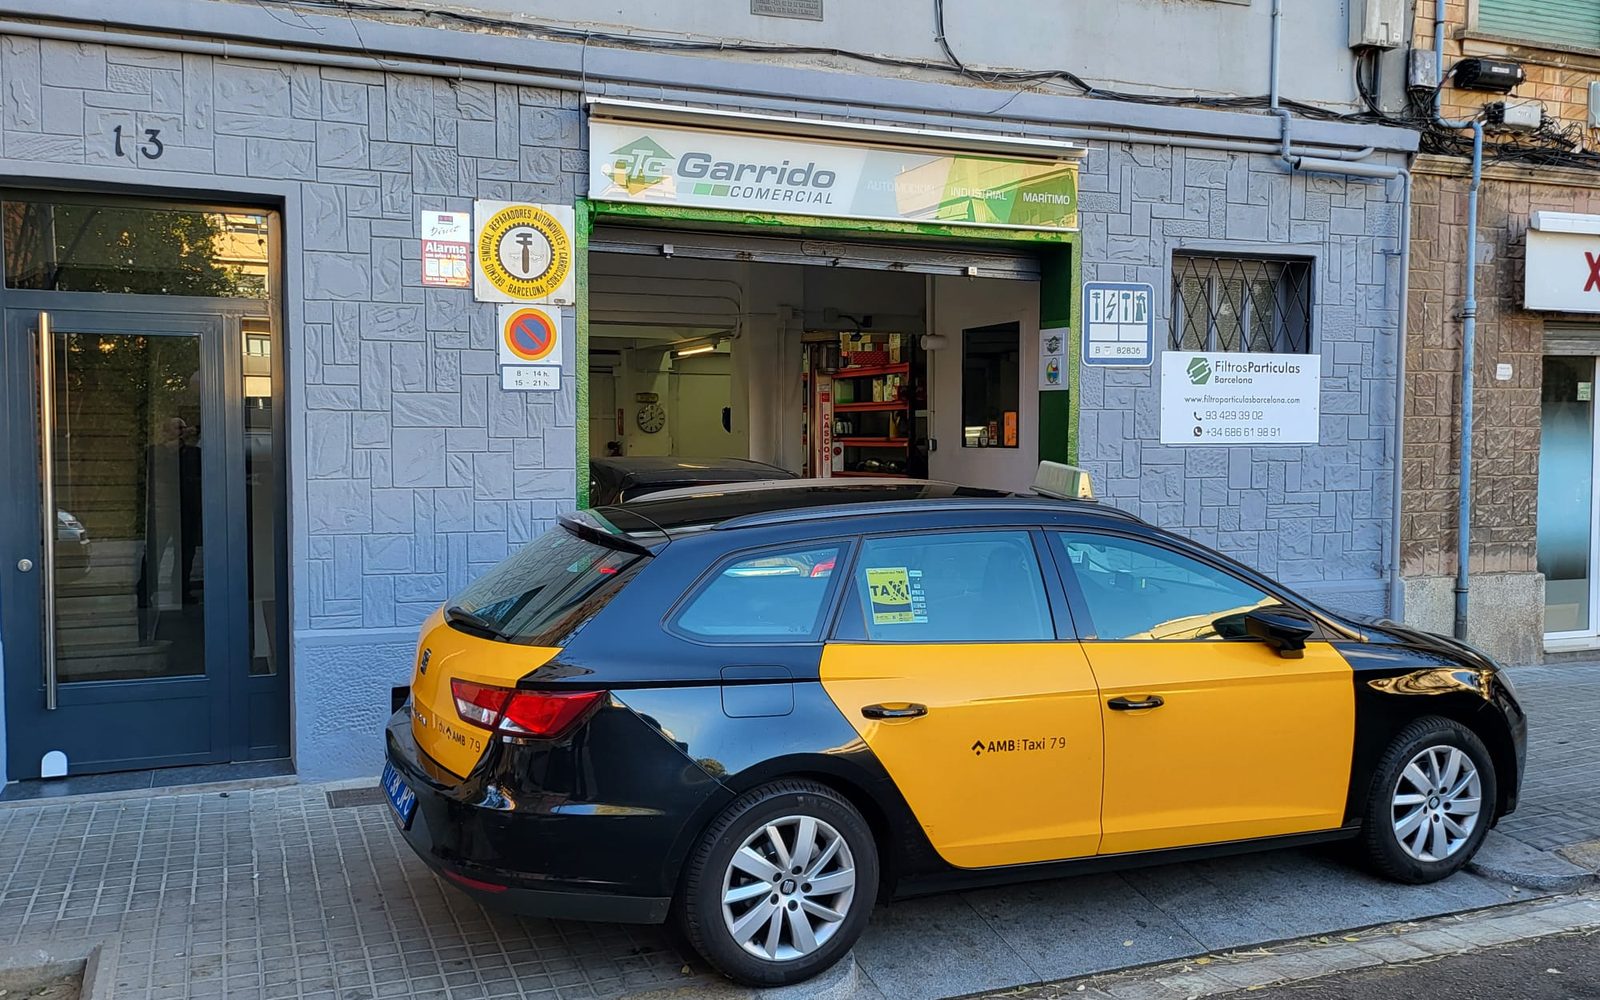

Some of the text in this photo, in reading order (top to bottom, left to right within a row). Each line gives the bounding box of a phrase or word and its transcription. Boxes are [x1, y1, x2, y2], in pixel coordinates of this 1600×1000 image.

[114, 125, 163, 160] 13
[676, 151, 836, 189] Garrido
[730, 185, 833, 204] COMERCIAL
[950, 186, 1007, 201] INDUSTRIAL
[1022, 191, 1071, 205] MARÍTIMO
[492, 209, 532, 231] REPARADORES
[425, 241, 466, 254] Alarma
[481, 233, 494, 262] SINDICAL
[485, 263, 505, 287] GREMIO
[548, 251, 568, 288] CARROCEROS
[507, 284, 546, 297] BARCELONA
[1215, 360, 1300, 374] FiltrosParticulas
[1214, 375, 1253, 384] Barcelona
[1205, 410, 1264, 420] 93 429 39 02
[1205, 427, 1281, 437] +34 686 61 98 91
[870, 580, 910, 601] TAXI
[453, 730, 481, 753] AMB 79
[987, 736, 1066, 752] AMB Taxi 79
[396, 784, 416, 816] JPC
